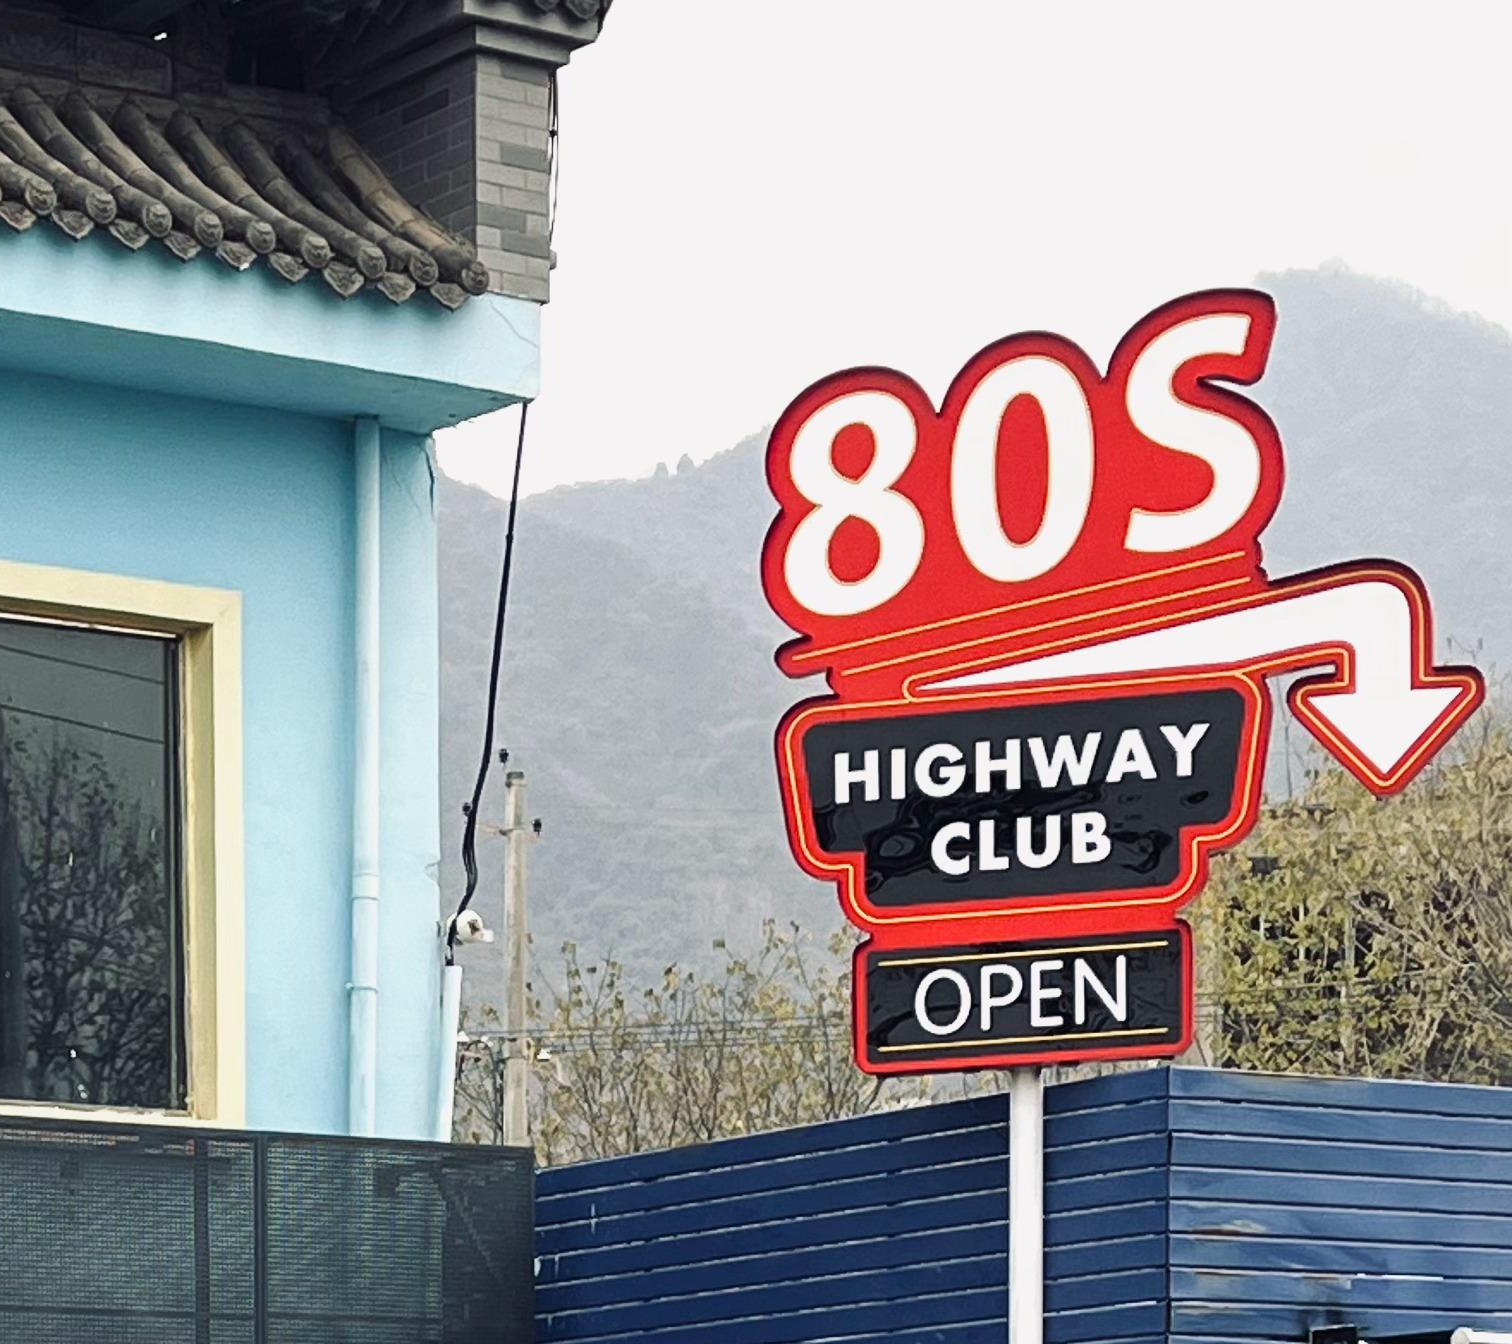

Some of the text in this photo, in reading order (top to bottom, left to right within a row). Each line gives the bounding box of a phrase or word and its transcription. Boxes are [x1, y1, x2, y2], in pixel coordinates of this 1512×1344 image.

[784, 312, 1260, 616] 80S
[834, 722, 1210, 805] HIGHWAY
[930, 812, 1112, 875] CLUB
[914, 955, 1129, 1036] OPEN
